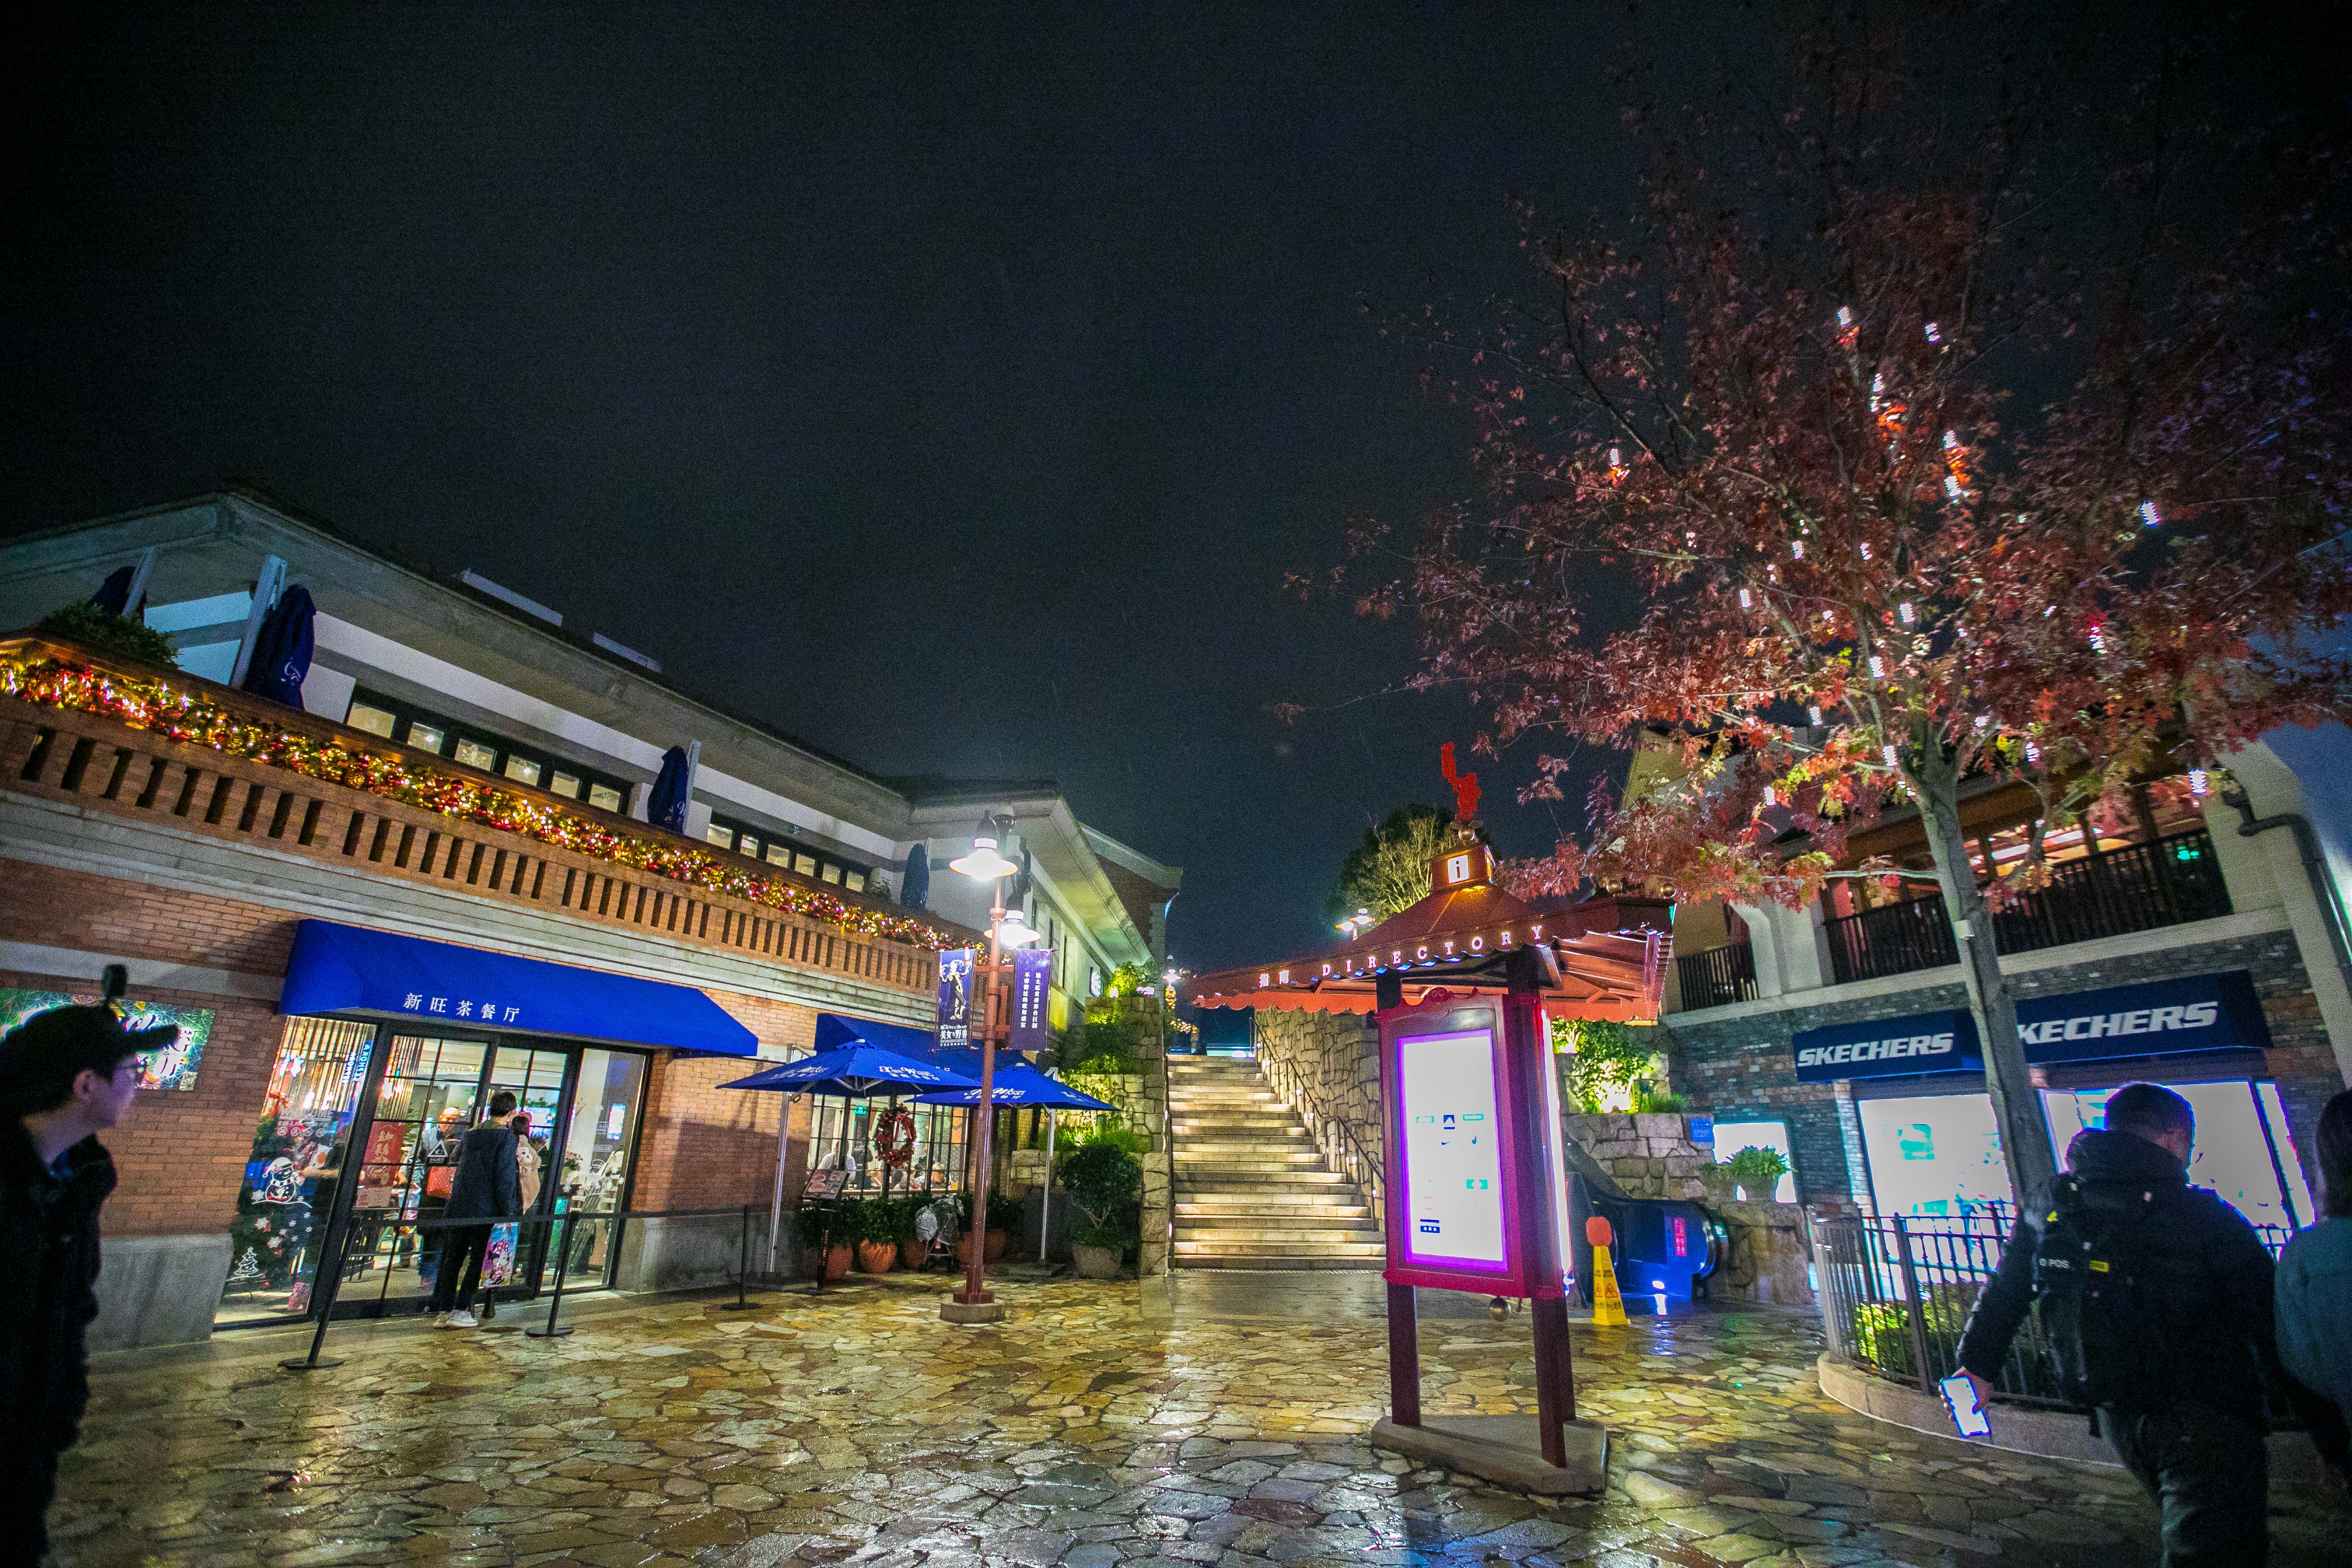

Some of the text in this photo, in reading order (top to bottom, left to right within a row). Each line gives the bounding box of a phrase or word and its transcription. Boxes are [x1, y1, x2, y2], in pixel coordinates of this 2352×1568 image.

[1322, 925, 1542, 977] DIRECTORY
[403, 992, 520, 1022] 新旺茶餐厅
[2016, 1001, 2219, 1045] KECHERS
[940, 1029, 968, 1040] 美女与野兽
[1797, 1032, 1955, 1067] SKECHERS
